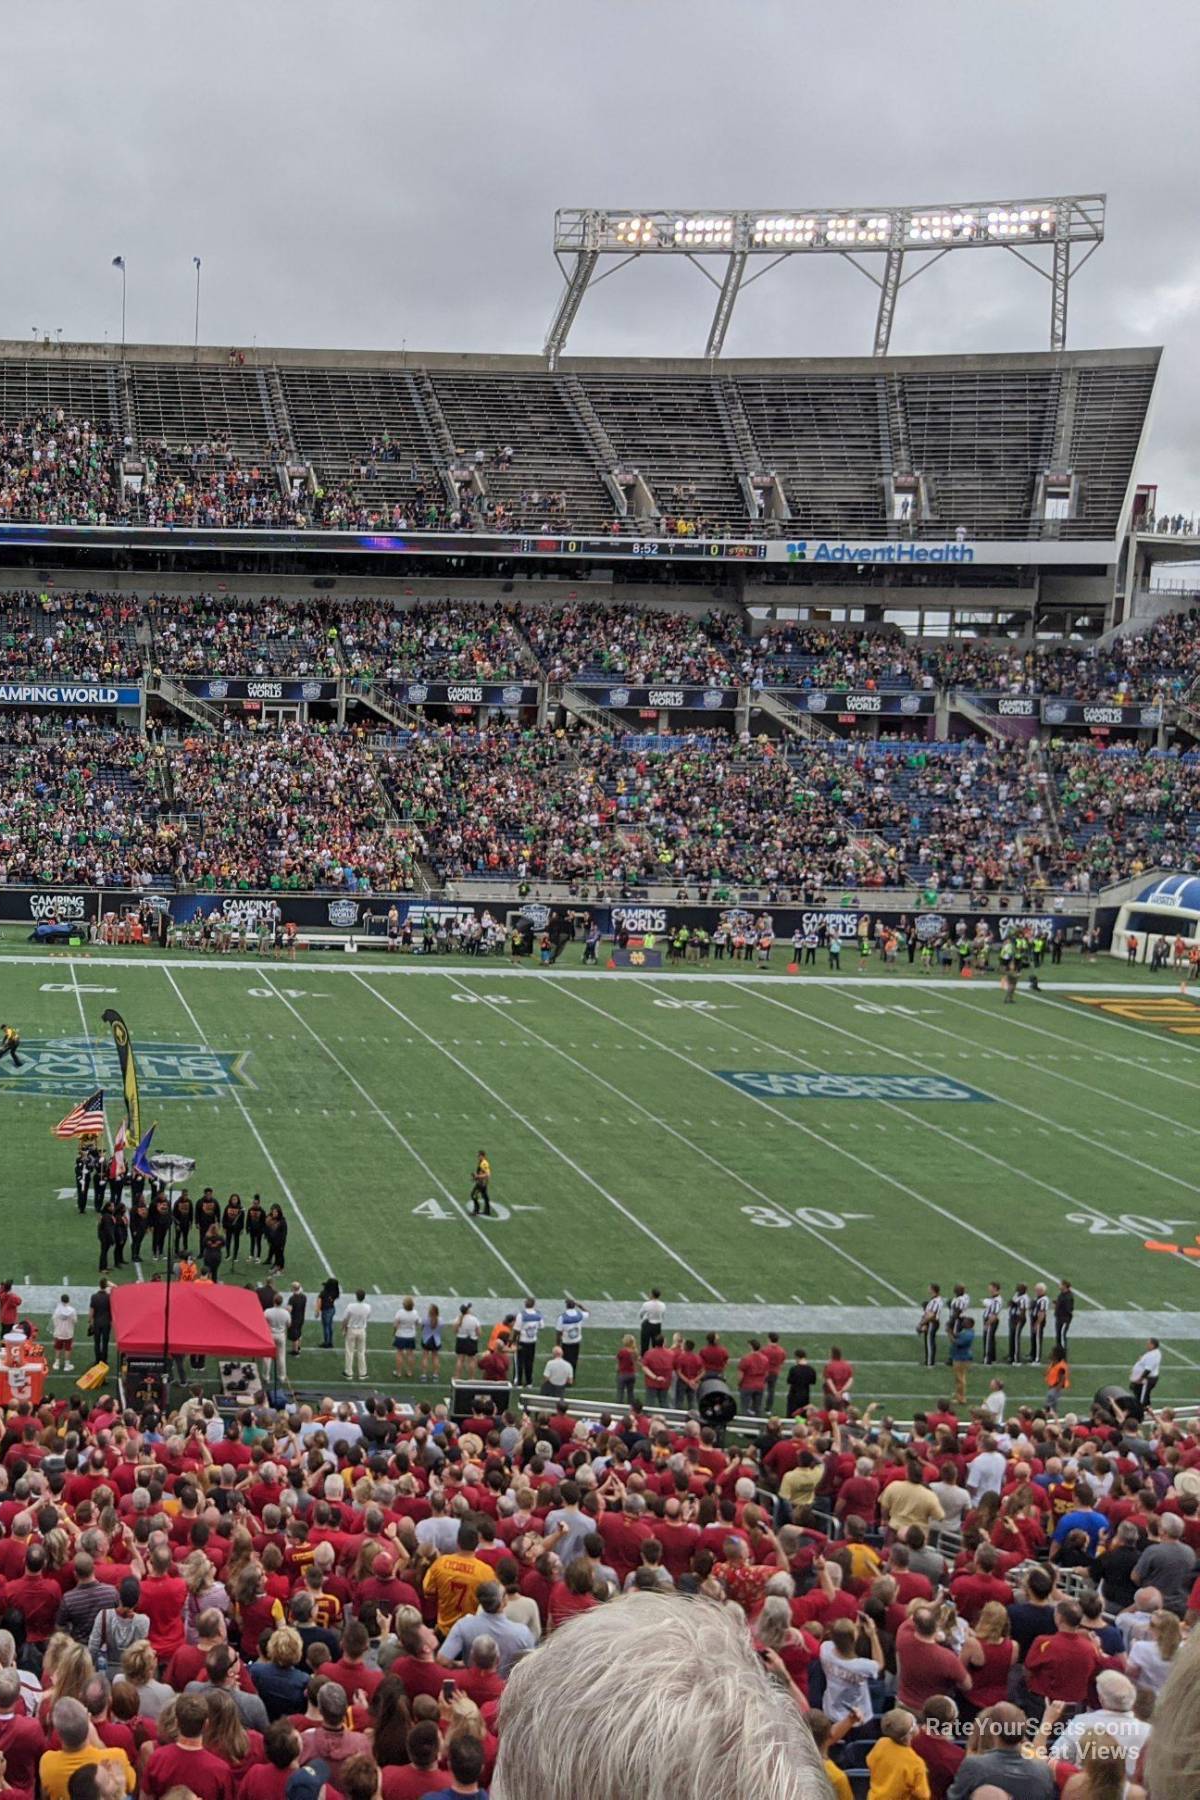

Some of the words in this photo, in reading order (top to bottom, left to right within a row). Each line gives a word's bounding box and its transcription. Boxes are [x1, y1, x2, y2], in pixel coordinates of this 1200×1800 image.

[568, 542, 576, 552] 0
[632, 544, 658, 554] 8:52
[710, 545, 718, 555] 0
[814, 544, 974, 562] AdventHealth
[60, 688, 118, 703] WORLD
[248, 690, 282, 698] WORLD
[448, 694, 482, 702] WORLD
[649, 698, 684, 706] WORLD
[847, 702, 881, 711] WORLD
[999, 706, 1033, 714] WORLD
[1084, 714, 1122, 723] WORLD
[30, 895, 84, 906] CAMPING
[611, 909, 666, 919] CAMPING
[802, 913, 857, 924] CAMPING
[999, 918, 1052, 929] CAMPING
[732, 1073, 950, 1087] CAMPING
[744, 1081, 971, 1099] WORLD
[412, 1198, 511, 1220] 40
[740, 1206, 846, 1229] 30
[1065, 1214, 1174, 1235] 20
[450, 1581, 468, 1614] 7
